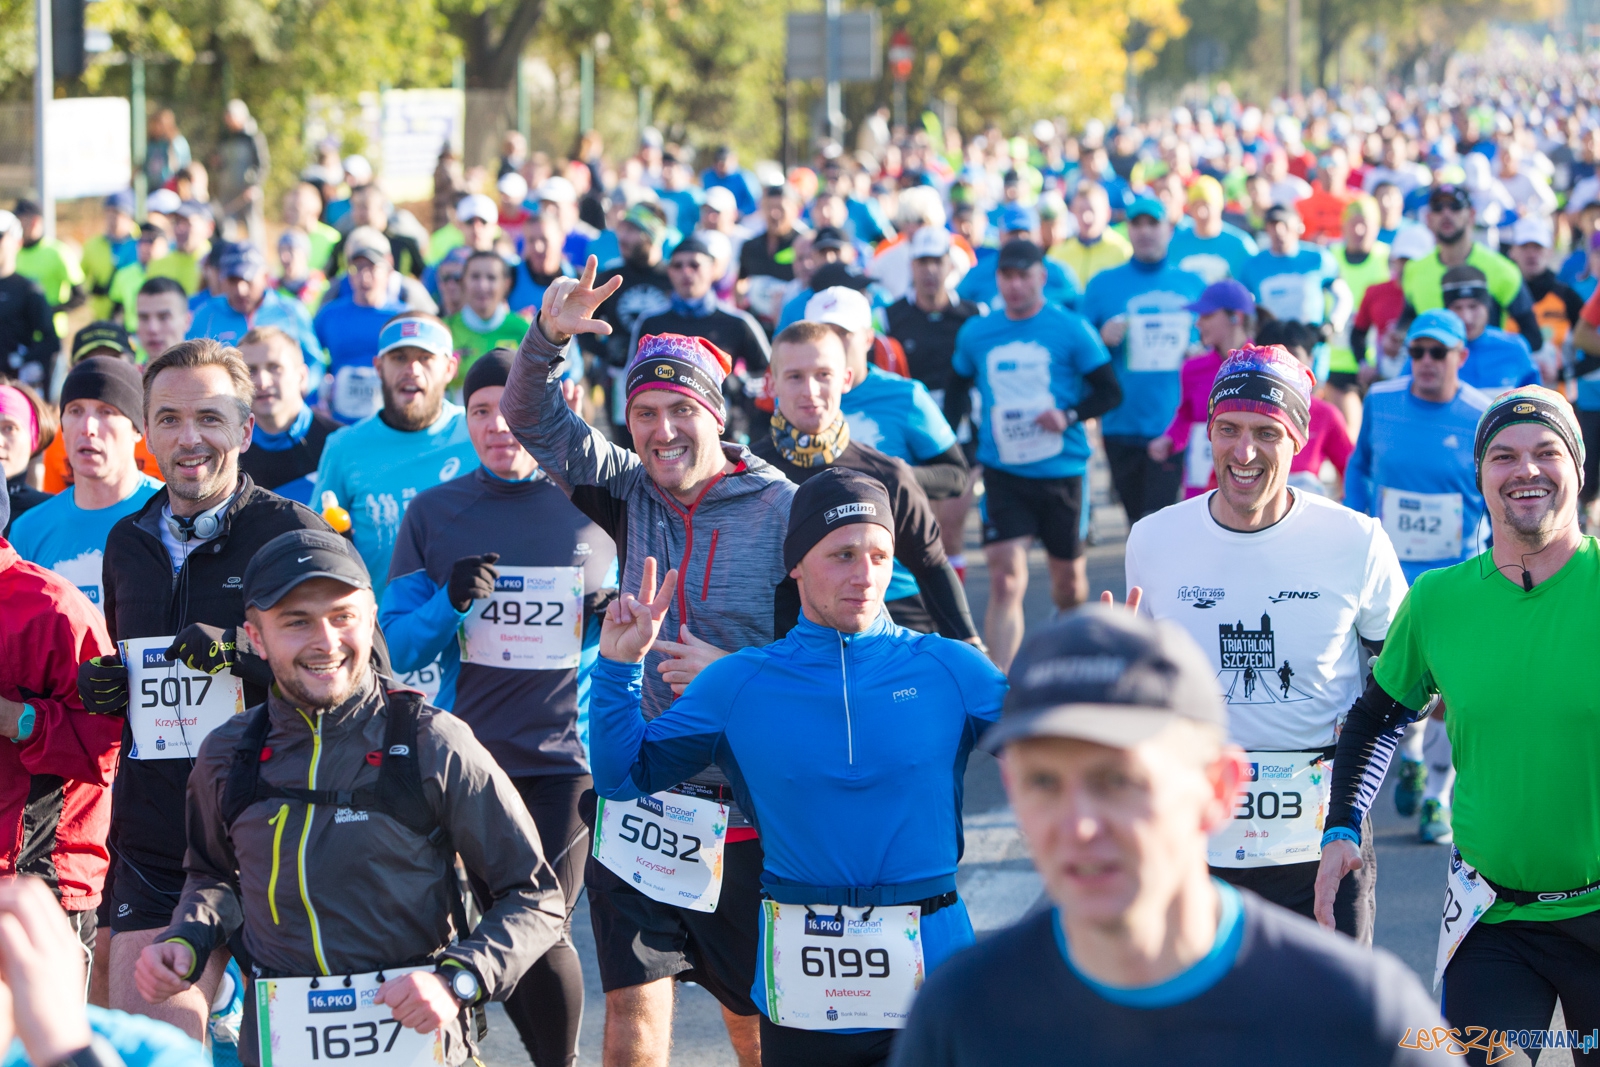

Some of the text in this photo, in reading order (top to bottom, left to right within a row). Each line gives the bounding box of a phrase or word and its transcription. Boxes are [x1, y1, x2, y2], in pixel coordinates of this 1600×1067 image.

[657, 366, 674, 377] Buff
[838, 503, 875, 515] viking
[1398, 514, 1442, 535] 842
[1277, 591, 1319, 600] FINIS
[480, 600, 564, 626] 4922
[220, 642, 237, 651] asic
[1222, 638, 1272, 652] TRIATHLON
[1223, 653, 1273, 668] SZCZECIN
[141, 675, 213, 708] 5017
[892, 687, 917, 700] PRO
[155, 717, 198, 728] Krzysztof
[336, 807, 354, 816] Jack
[1234, 791, 1302, 820] 303
[334, 812, 369, 824] Wolfskin
[666, 811, 694, 823] maraton
[619, 813, 702, 863] 5032
[1244, 830, 1269, 838] Jakub
[636, 856, 676, 875] Krzysztof
[801, 946, 890, 979] 6199
[825, 989, 871, 998] Mateusz
[305, 1018, 403, 1060] 1637
